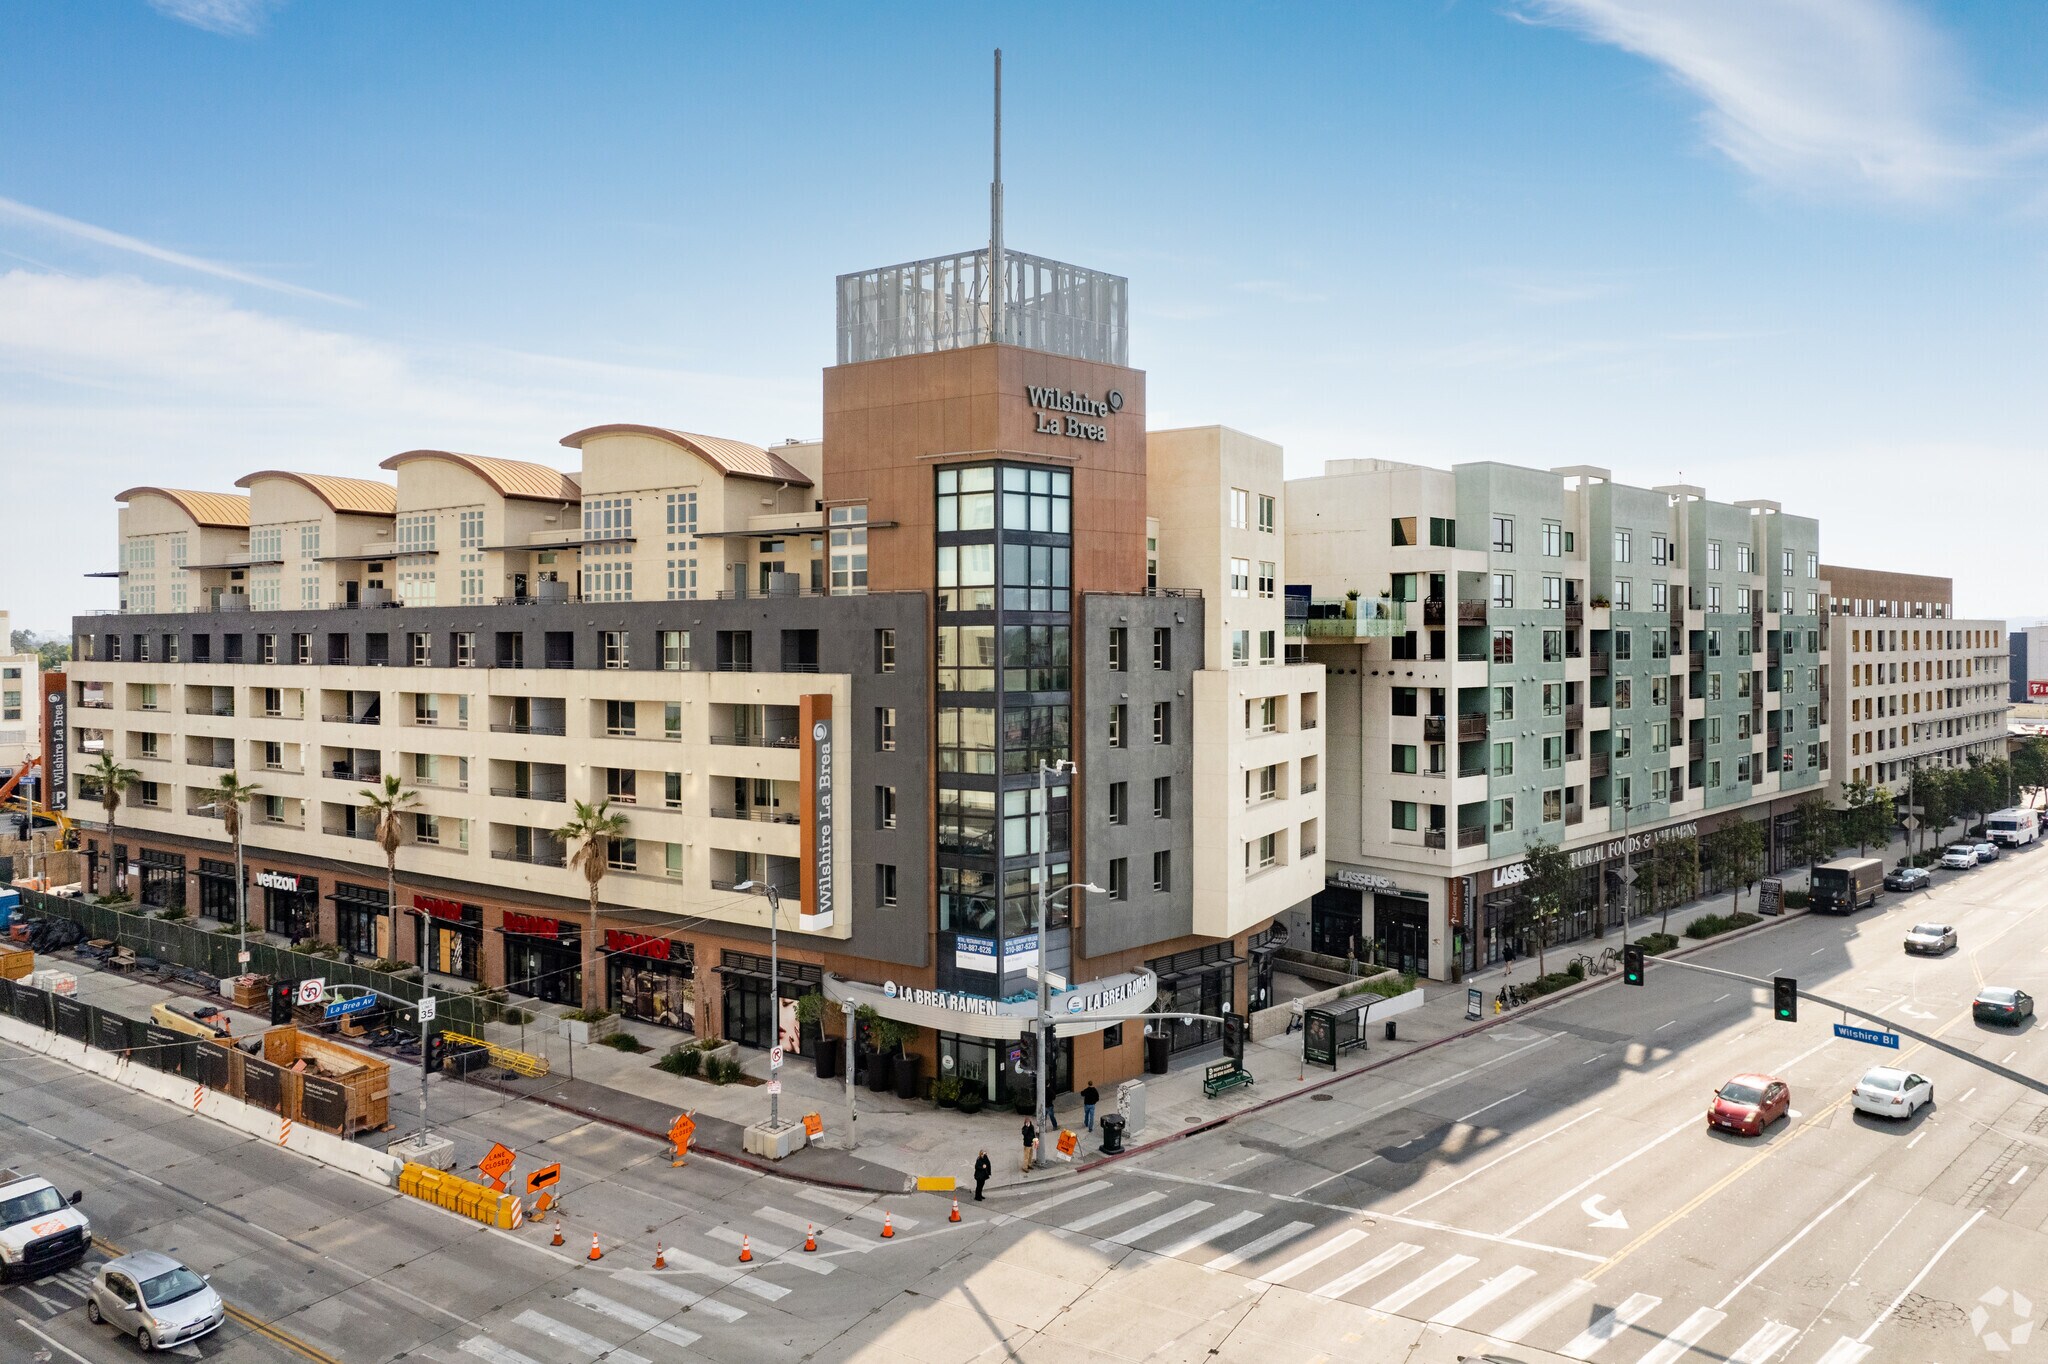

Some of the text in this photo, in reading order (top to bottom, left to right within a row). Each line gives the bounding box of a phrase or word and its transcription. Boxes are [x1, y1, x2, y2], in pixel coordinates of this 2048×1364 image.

[1026, 384, 1109, 418] Wilshire
[1036, 411, 1108, 442] La Brea
[53, 703, 64, 726] Brea
[53, 729, 64, 741] La
[53, 743, 64, 786] Wilshire
[819, 741, 832, 912] Wilshire La Brea
[256, 871, 298, 892] verizon
[1337, 869, 1390, 888] LASSENS
[899, 985, 997, 1016] LA BREA RAMEN
[1087, 973, 1151, 1012] LA BREA RAMEN
[330, 997, 373, 1014] La Brea Av
[420, 1008, 434, 1019] 35
[1838, 1027, 1894, 1045] Wilshire Bl
[672, 1126, 693, 1139] CLOSED
[676, 1120, 688, 1130] LANE
[484, 1158, 510, 1170] CLOSED
[488, 1152, 505, 1161] LANE
